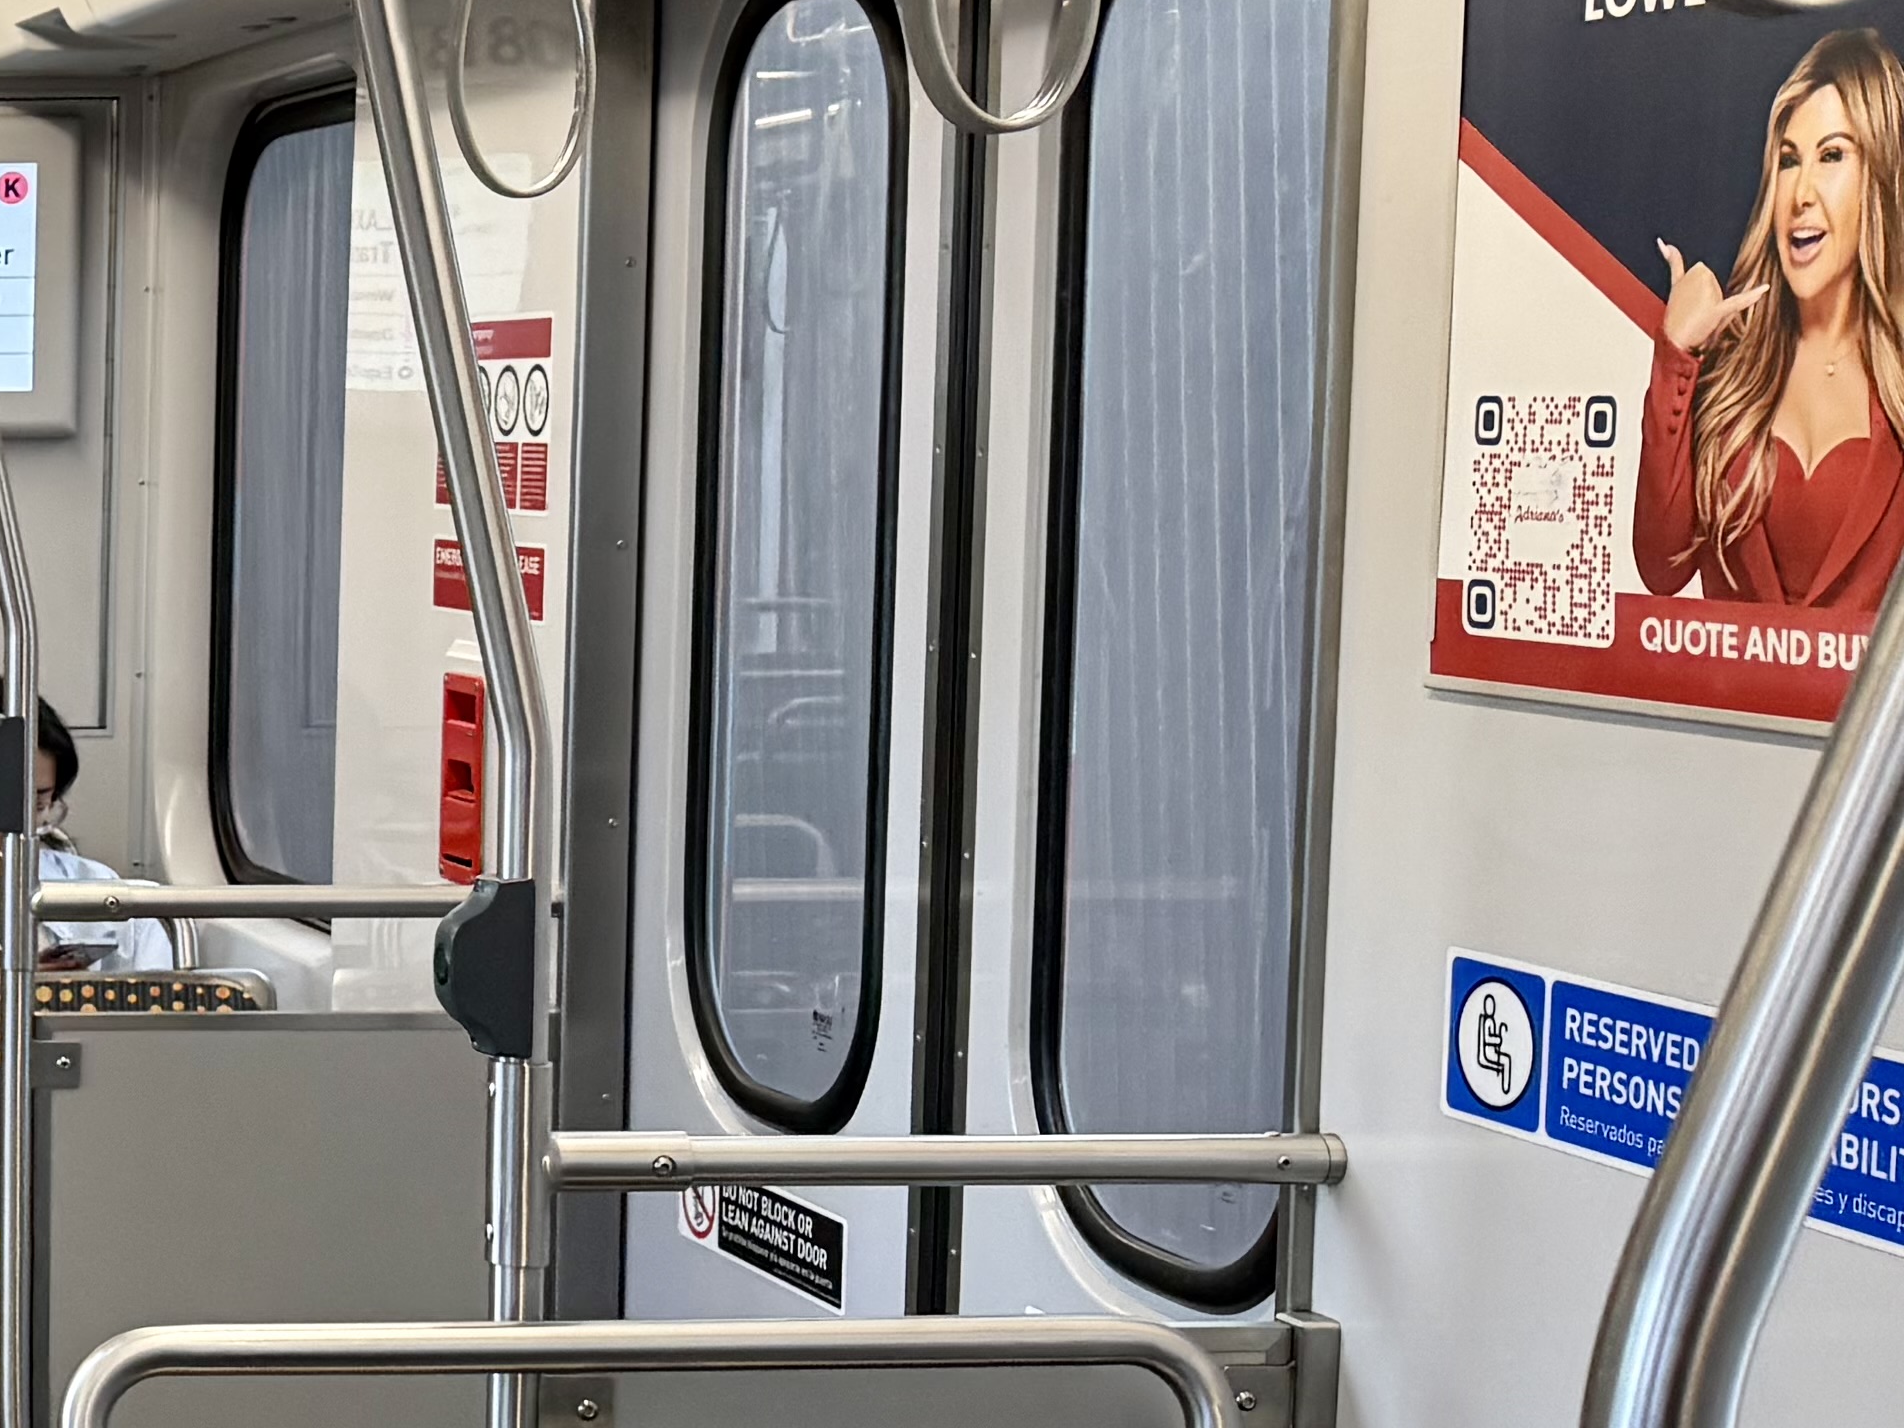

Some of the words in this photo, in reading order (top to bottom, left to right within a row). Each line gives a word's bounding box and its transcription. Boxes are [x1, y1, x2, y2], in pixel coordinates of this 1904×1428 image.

[4, 178, 20, 198] K
[1640, 617, 1739, 660] QUOTE
[1744, 628, 1812, 666] AND
[1565, 1007, 1701, 1073] RESERVED
[1562, 1057, 1683, 1121] PERSONS
[1559, 1105, 1644, 1150] Reservados
[722, 1201, 749, 1232] LEAN
[750, 1215, 796, 1255] AGAINST
[797, 1237, 828, 1271] DOOR
[738, 1185, 760, 1213] NOT
[761, 1194, 796, 1231] BLOCK
[797, 1213, 813, 1239] OR
